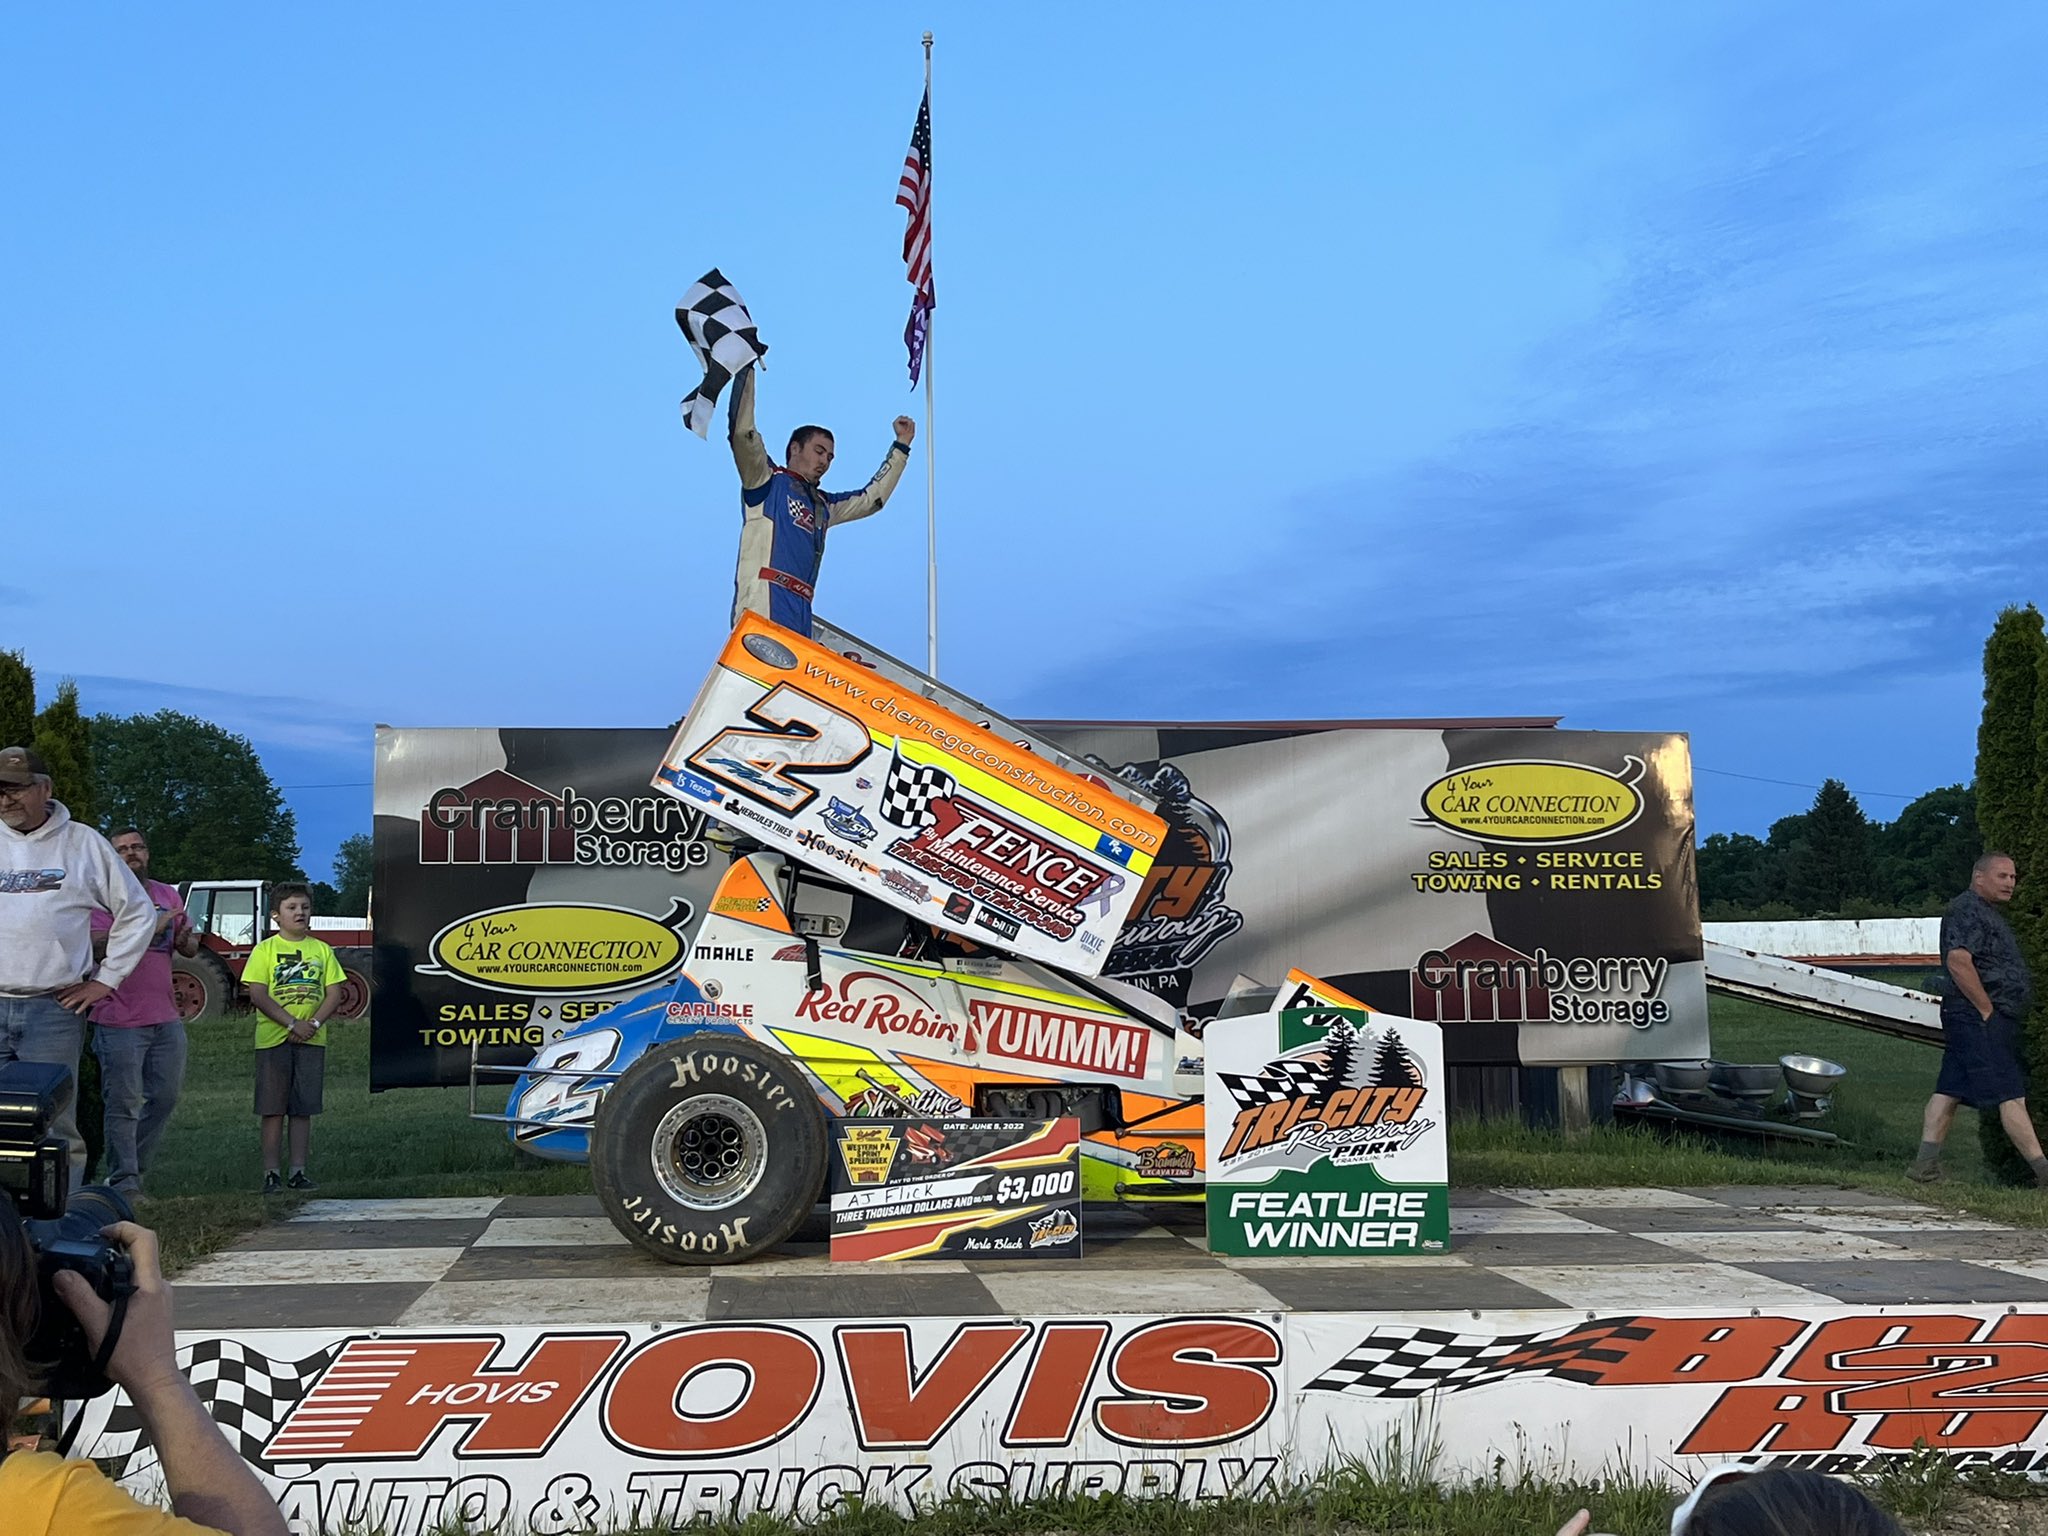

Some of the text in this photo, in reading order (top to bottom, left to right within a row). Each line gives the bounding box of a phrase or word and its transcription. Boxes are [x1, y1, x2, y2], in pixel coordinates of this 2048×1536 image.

[684, 681, 872, 817] 2
[804, 662, 1156, 847] www.chernegaconstruction.com
[688, 780, 713, 798] Tezos
[1447, 776, 1494, 793] 4 Your
[428, 787, 706, 840] Cranberry
[1441, 795, 1620, 813] CAR CONNECTION
[740, 806, 774, 828] HERCULES
[774, 823, 794, 838] TIRES
[850, 822, 877, 839] STAR
[1460, 815, 1605, 825] www.4YOURCARCONNECTION.com
[922, 828, 938, 841] By
[575, 836, 708, 872] Storage
[799, 829, 868, 872] Hoosier
[942, 802, 1099, 899] FENCE
[1429, 852, 1644, 869] SALES SERVICE
[926, 838, 1024, 895] Maintenance
[1023, 888, 1085, 925] Service
[1412, 872, 1663, 892] TOWING RENTALS
[463, 919, 518, 941] 4 Your
[977, 910, 1006, 930] Mobil
[455, 940, 662, 961] CAR CONNECTION
[1081, 931, 1105, 952] DIXIE
[694, 946, 754, 961] MAHLE
[476, 963, 642, 974] www.4YOURCARCONNECTION.com
[1417, 948, 1668, 998] Cranberry
[1158, 974, 1179, 989] PA
[439, 1004, 529, 1022] SALES
[666, 1016, 754, 1025] CEMENT PRODUCTS
[667, 1002, 754, 1018] CARLISLE
[795, 981, 959, 1043] Red Robin
[1550, 995, 1670, 1029] Storage
[418, 1027, 543, 1046] TOWING
[976, 1004, 1142, 1073] YUMMM!
[669, 1050, 795, 1111] Hoosier
[1218, 1086, 1427, 1162] TRI-CITY
[847, 1142, 891, 1151] WESTERN PA
[1284, 1118, 1436, 1155] Raceway
[856, 1150, 881, 1158] SPRINT
[1332, 1140, 1401, 1158] PARK
[1335, 1155, 1381, 1164] FRANKLIN,
[848, 1157, 888, 1165] SPEEDWEEK
[924, 1173, 946, 1182] ORDER
[1141, 1168, 1190, 1176] EXCAVATING
[997, 1170, 1075, 1205] $3,000
[836, 1210, 865, 1223] THREE
[865, 1205, 913, 1219] THOUSAND
[914, 1198, 953, 1216] DOLLARS
[953, 1195, 973, 1208] AND
[848, 1192, 875, 1207] AJ
[1229, 1192, 1429, 1218] FEATURE
[622, 1196, 751, 1254] Hoosier
[1243, 1222, 1419, 1249] WINNER
[993, 1237, 1023, 1250] Black
[260, 1316, 1284, 1461] HOVIS
[406, 1381, 560, 1406] HOVIS
[277, 1457, 1280, 1536] AUTO & TRUCK SUPPLY
